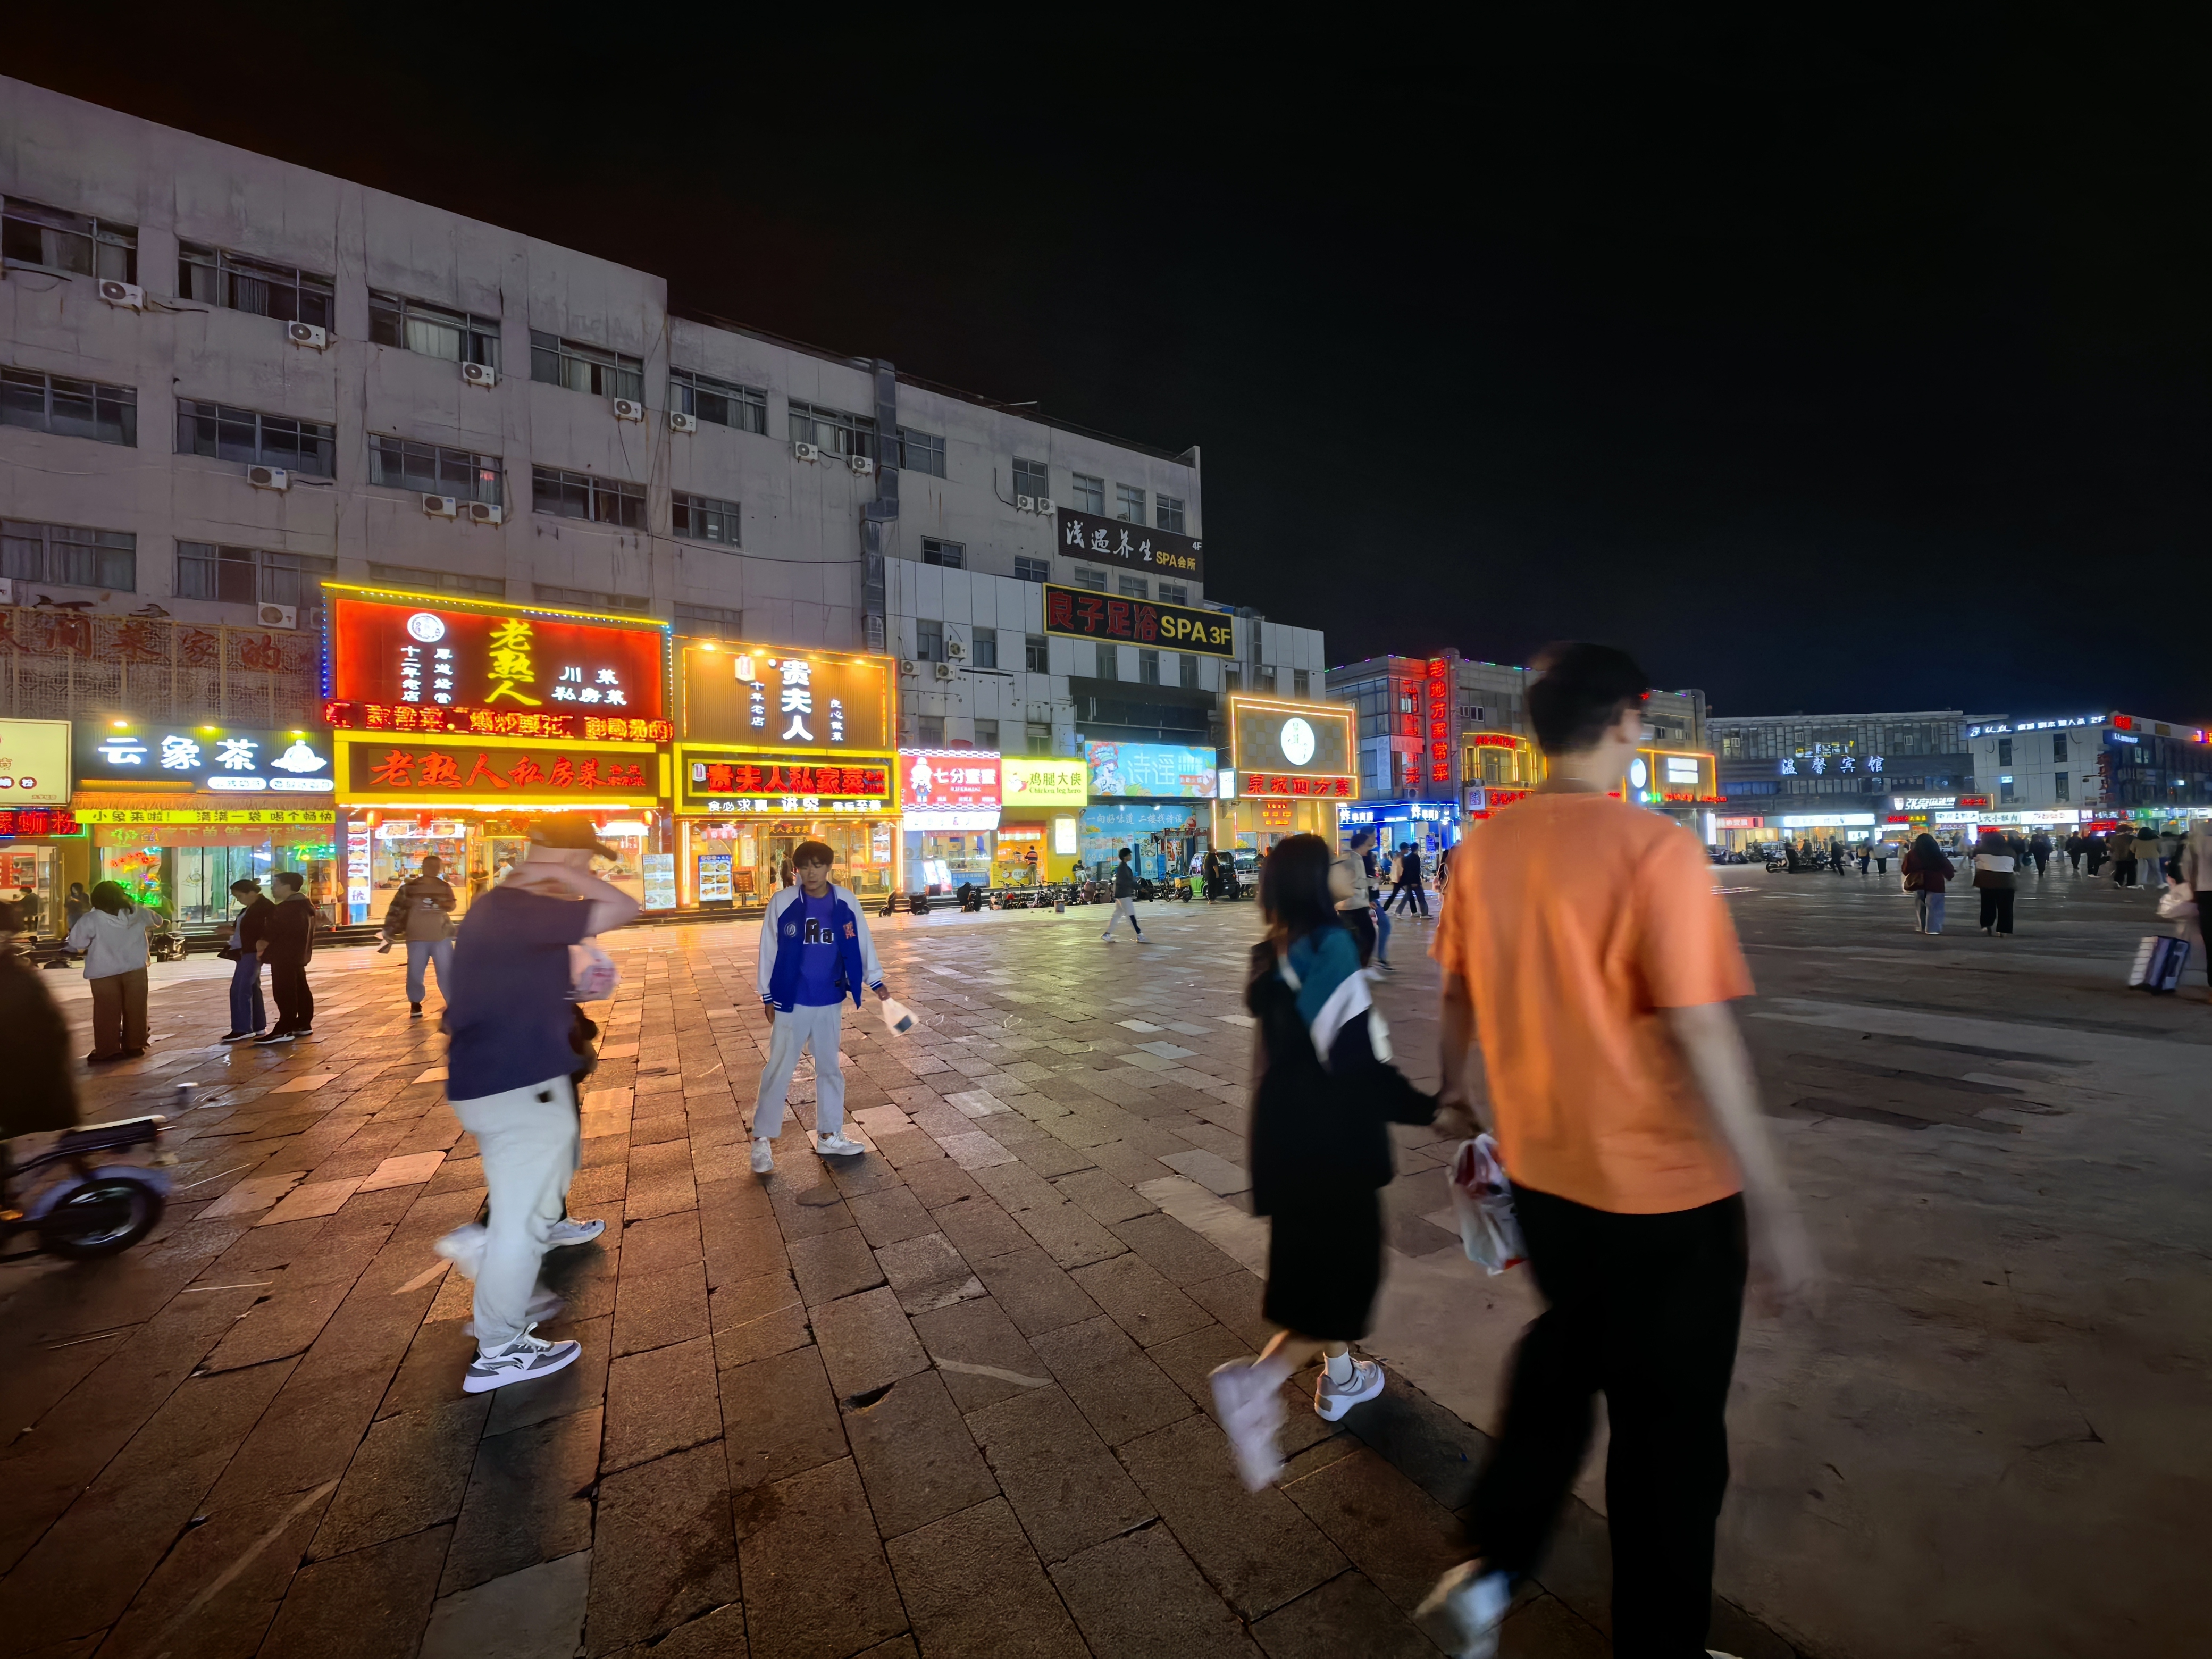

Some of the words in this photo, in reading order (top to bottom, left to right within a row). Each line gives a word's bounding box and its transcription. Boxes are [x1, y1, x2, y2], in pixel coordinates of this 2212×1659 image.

[1192, 541, 1202, 551] 4F
[1156, 551, 1196, 571] SPA会所
[1048, 591, 1158, 641] 良子足浴
[1160, 615, 1208, 643] SPA
[1209, 626, 1231, 645] 3F
[401, 645, 421, 702] 十二年老店
[484, 618, 542, 706] 老熟人
[551, 686, 627, 706] 私房菜
[750, 681, 765, 726] 十年老店
[780, 660, 814, 741] 贵夫人
[1429, 660, 1449, 782] 老地方家常菜
[98, 736, 258, 770] 云象茶
[1782, 756, 1884, 775] 温馨宾馆
[370, 750, 607, 789] 老熟人私房菜
[706, 764, 865, 794] 贵夫人私家菜
[1029, 772, 1082, 786] 鸡腿大侠
[1247, 775, 1351, 796] 泉城四方菜
[197, 811, 262, 822] 满满一袋
[271, 811, 333, 822] 喝个畅快
[781, 797, 819, 812] 讲究
[1087, 813, 1134, 824] 一向好味道
